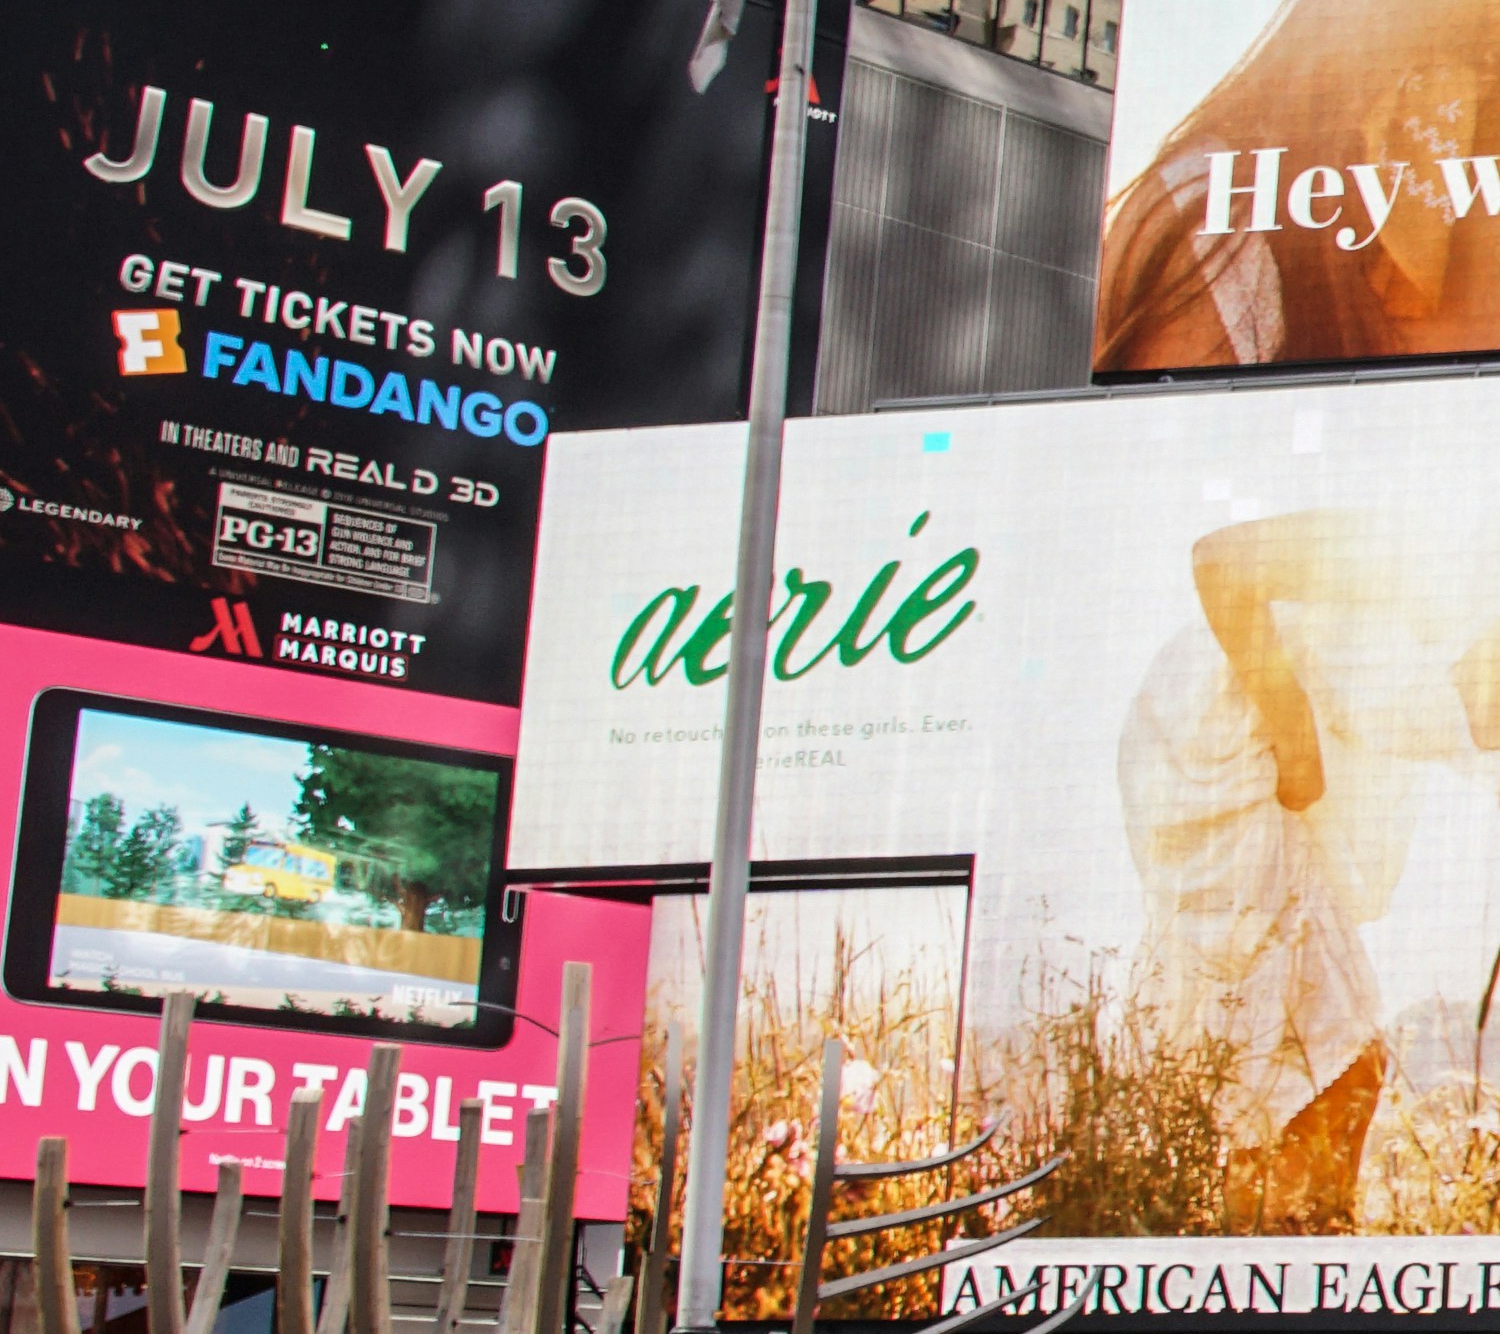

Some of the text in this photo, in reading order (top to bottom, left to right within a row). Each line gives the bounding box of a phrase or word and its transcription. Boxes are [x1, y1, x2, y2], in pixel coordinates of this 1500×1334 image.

[83, 86, 607, 296] JULY 13
[1195, 145, 1411, 252] Hey
[118, 253, 557, 383] GET TICKETS NOW
[202, 330, 549, 446] FANDANGO
[160, 420, 179, 444] IN
[181, 424, 264, 463] THEATERS
[266, 438, 299, 467] AND
[449, 476, 500, 507] 3D
[19, 497, 143, 531] LEGENDARY
[219, 514, 319, 558] PG-13
[281, 611, 426, 655] MARRIOTT
[610, 510, 979, 690] aerie
[279, 638, 406, 678] MARQUIS
[393, 985, 464, 1009] NETFLIX
[64, 1040, 276, 1127] YOUR
[946, 1261, 1288, 1315] AMERICAN
